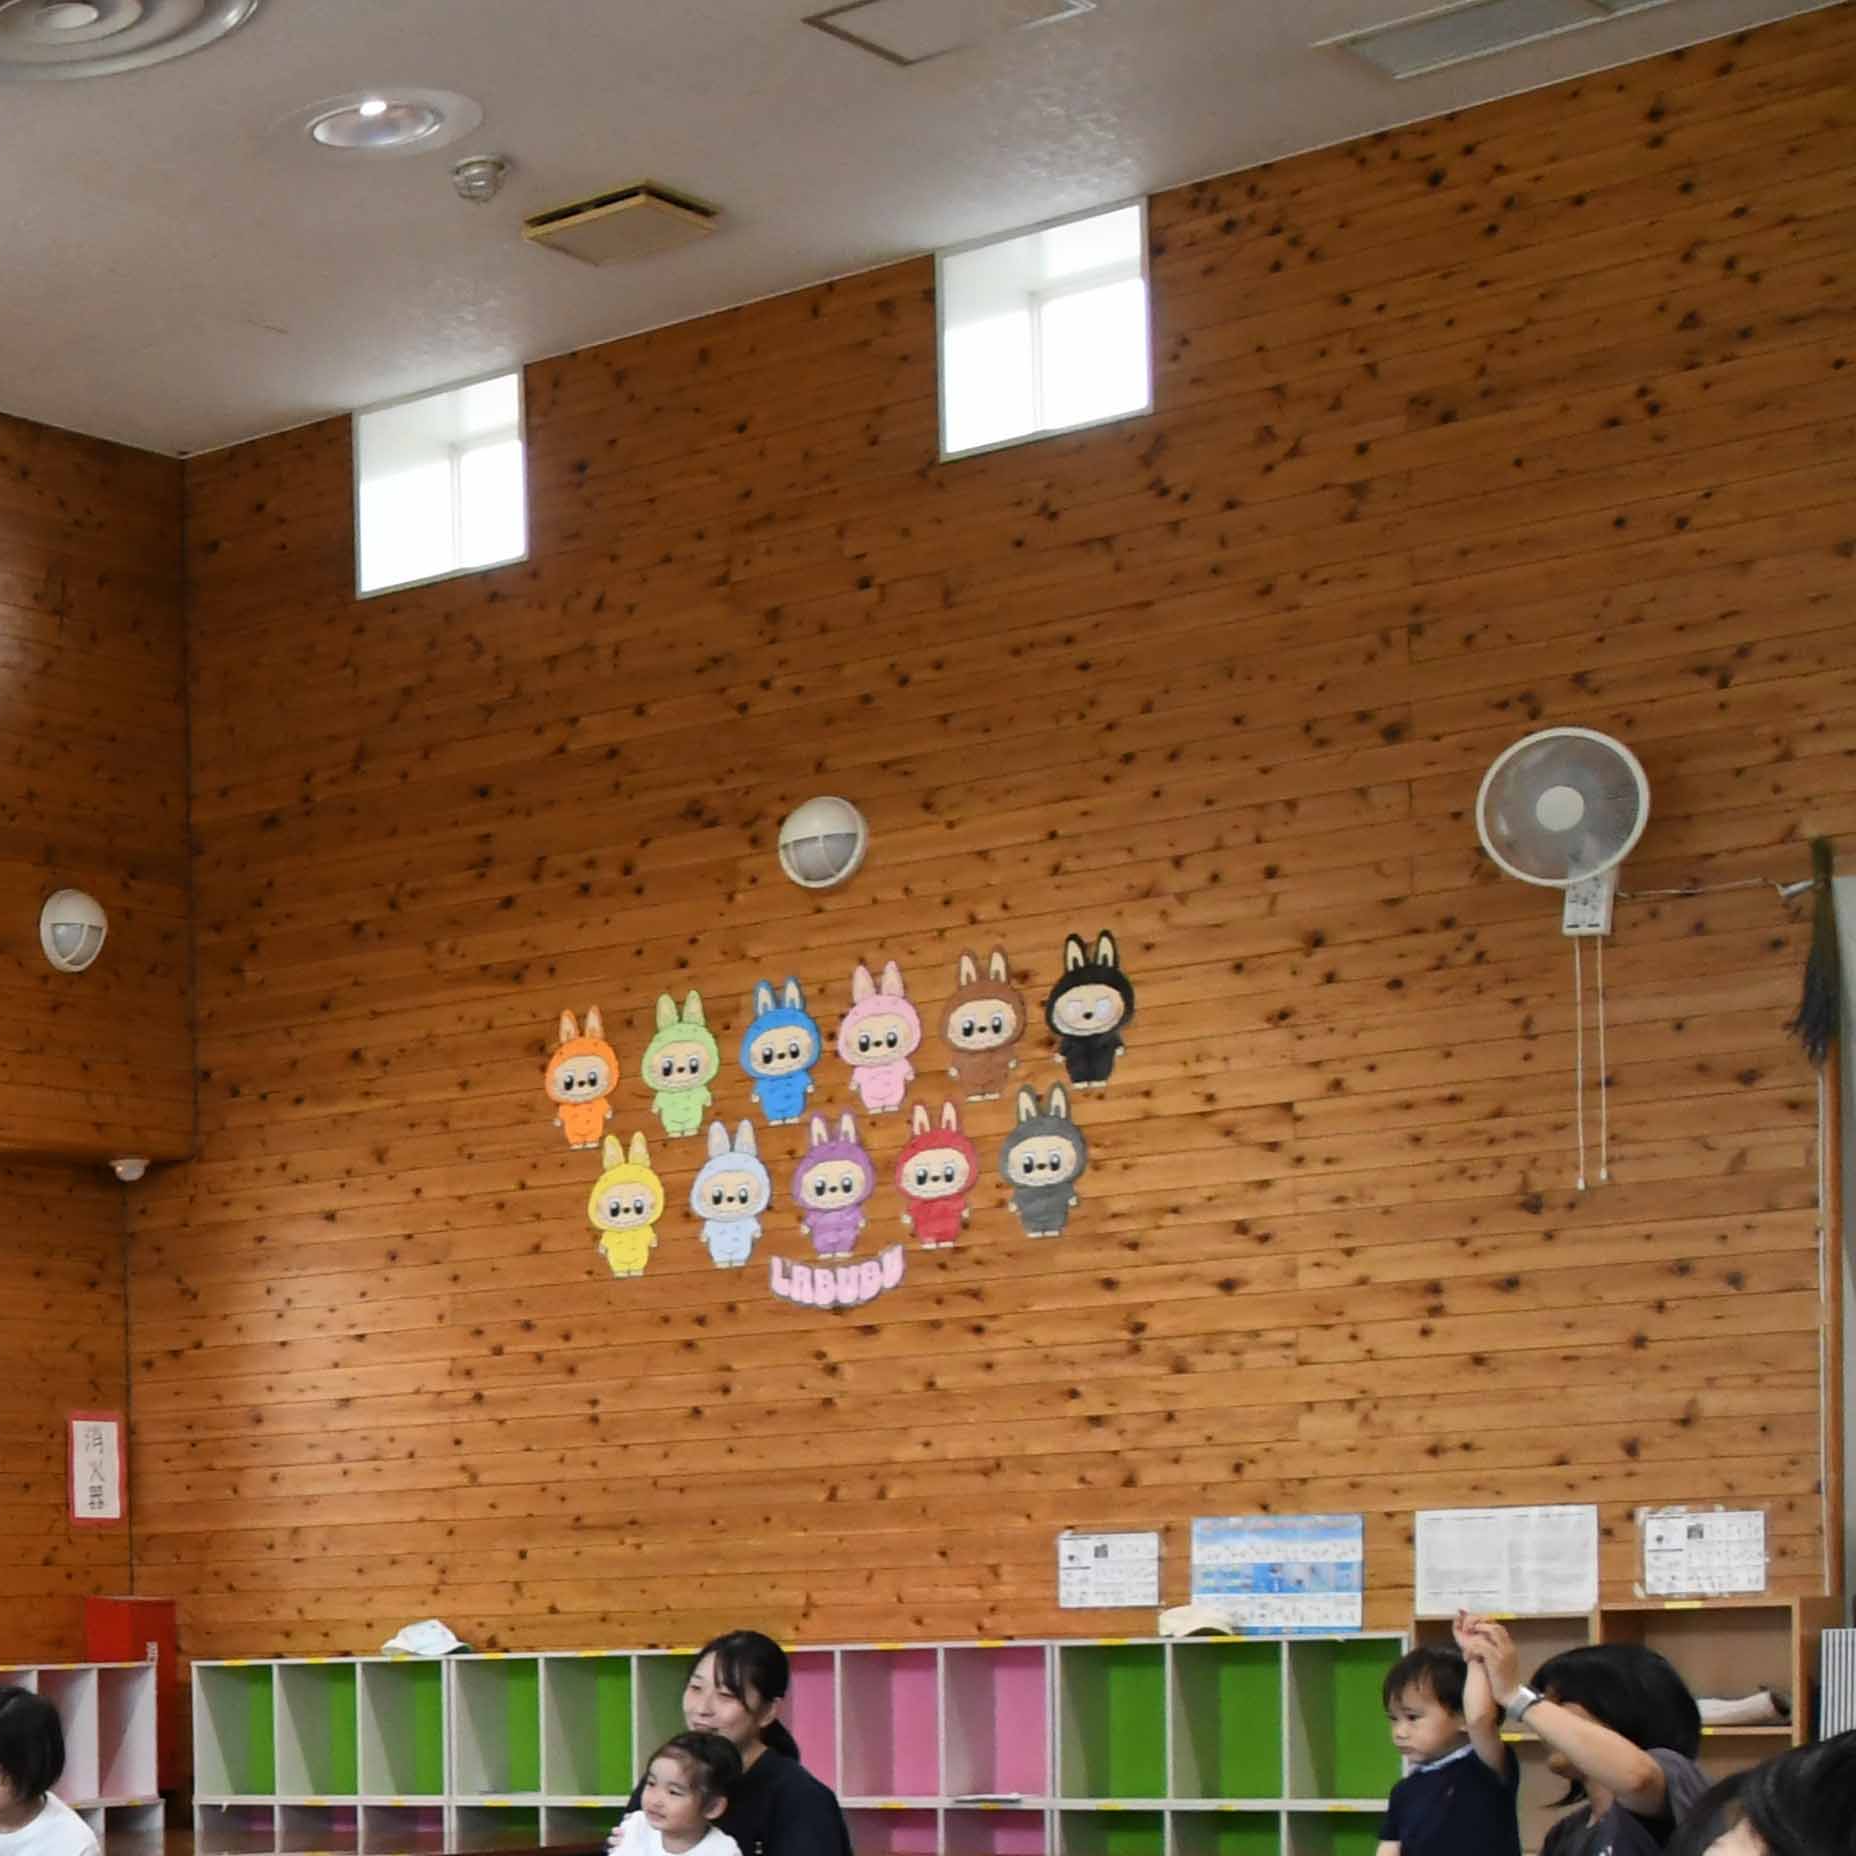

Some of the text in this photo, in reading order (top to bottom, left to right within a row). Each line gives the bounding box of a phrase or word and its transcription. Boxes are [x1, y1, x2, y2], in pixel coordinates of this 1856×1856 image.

[770, 1244, 904, 1305] LABUBU
[84, 1426, 105, 1510] 消火器
